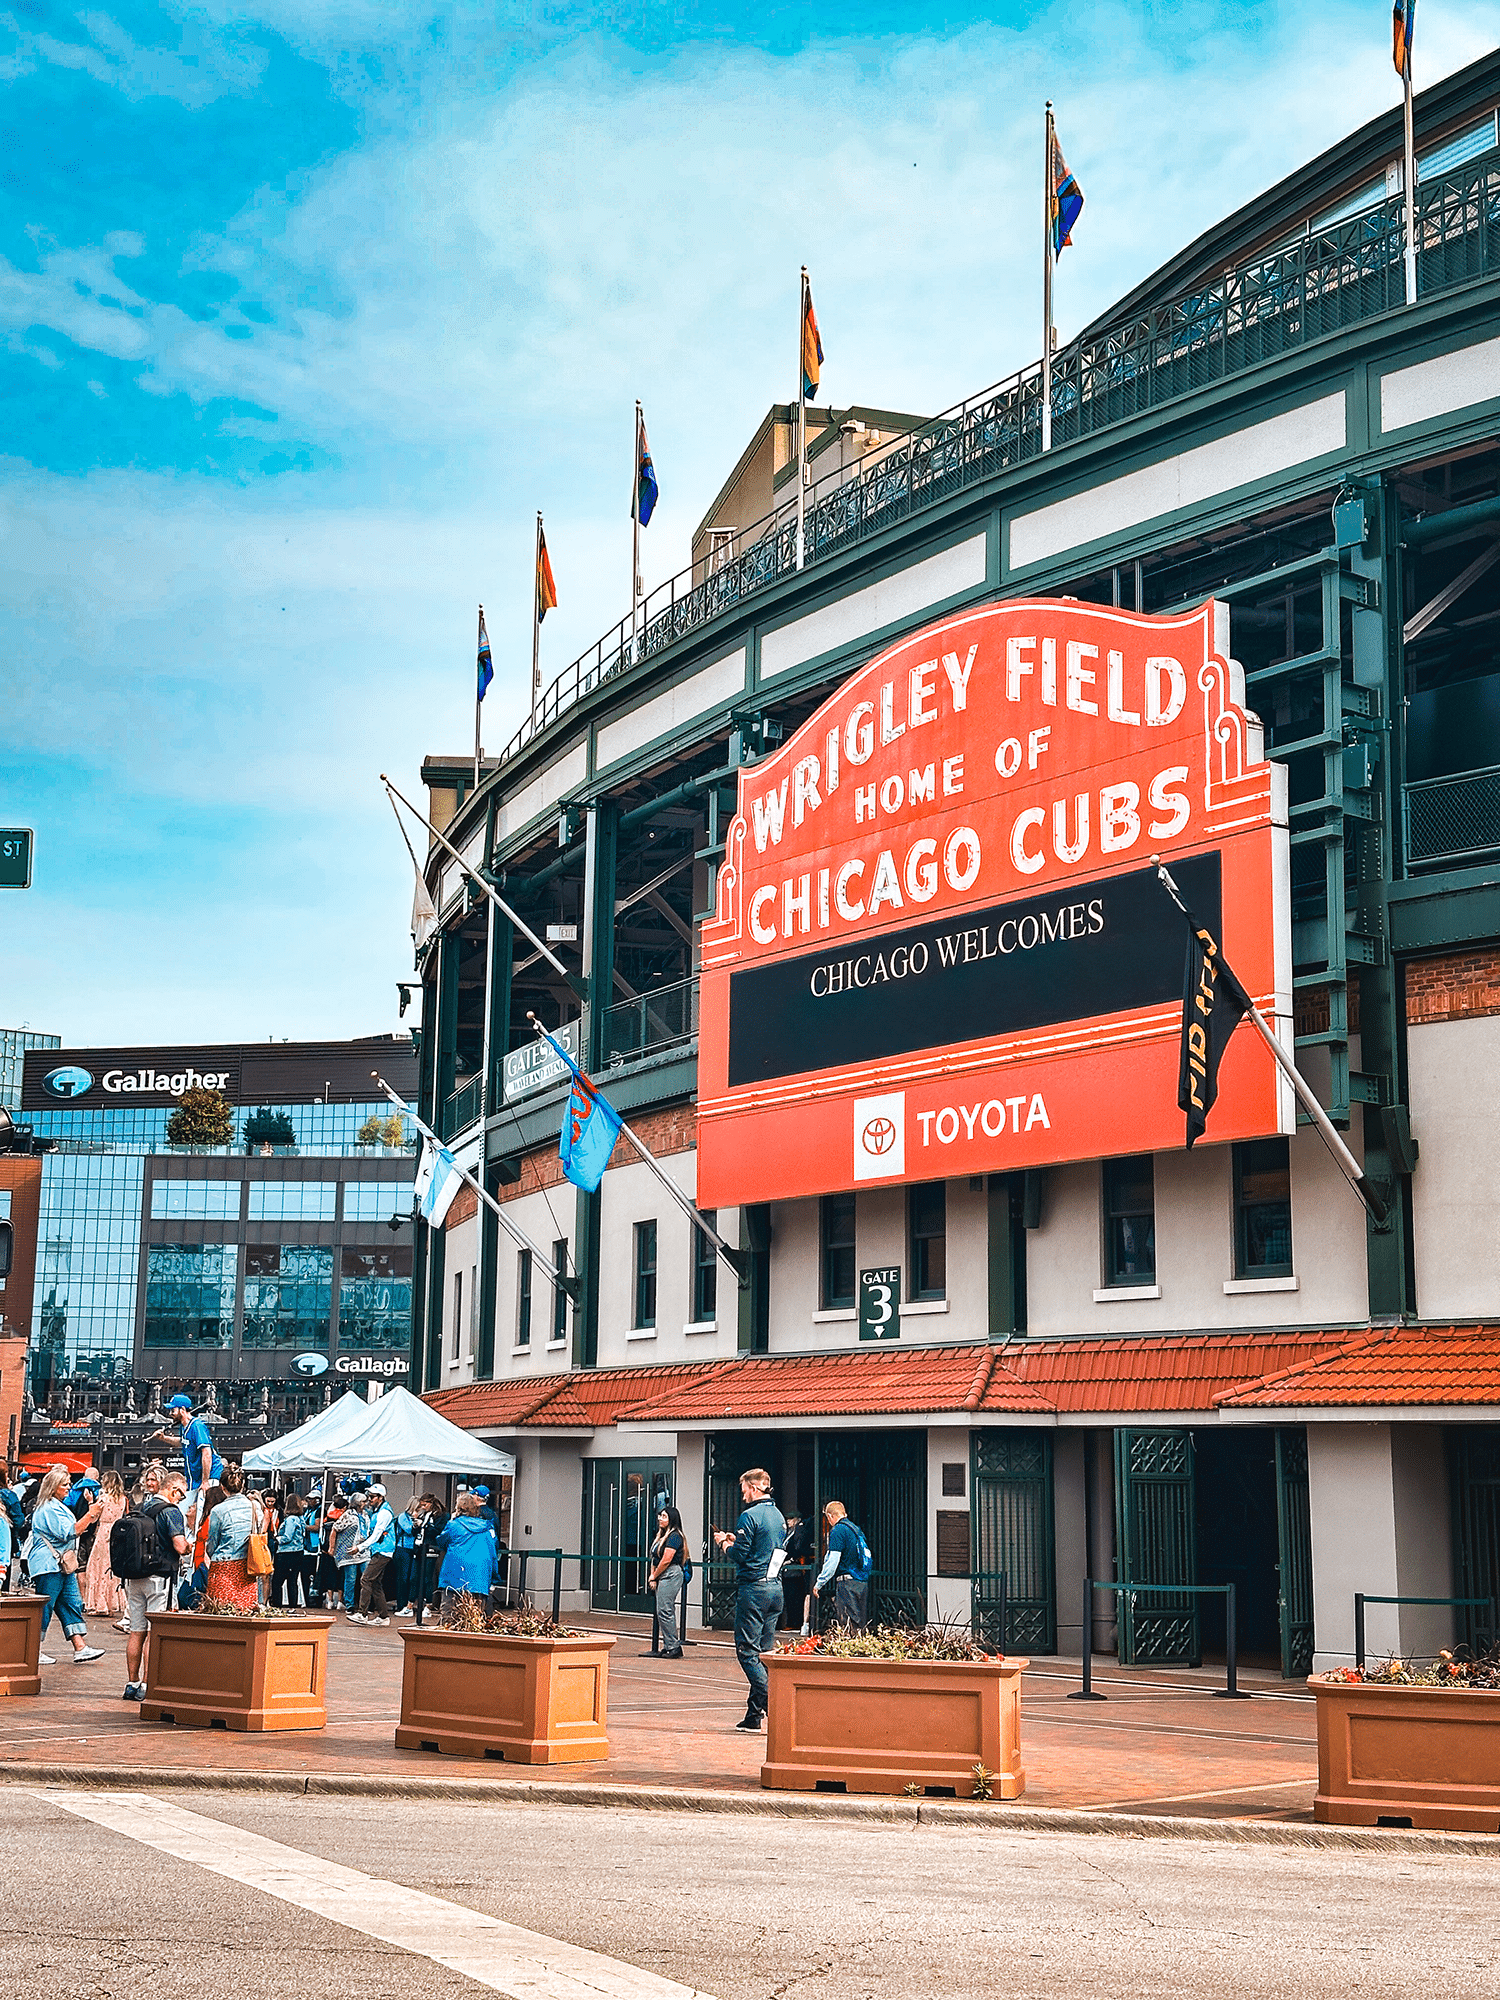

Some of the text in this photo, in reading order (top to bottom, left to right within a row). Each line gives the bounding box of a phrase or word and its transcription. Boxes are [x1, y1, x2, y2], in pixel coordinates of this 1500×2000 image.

[751, 636, 1188, 853] WRIGLEY FIELD
[855, 725, 1052, 824] HOME OF
[3, 840, 23, 857] ST
[748, 766, 1191, 945] CHICAGO CUBS
[810, 899, 1104, 997] CHICAGO WELCOMES
[507, 1040, 548, 1077] GATES
[102, 1068, 230, 1096] Gallagher
[916, 1093, 1051, 1148] TOYOTA
[862, 1269, 898, 1285] GATE
[866, 1285, 893, 1324] 3
[335, 1356, 410, 1376] Gallagh
